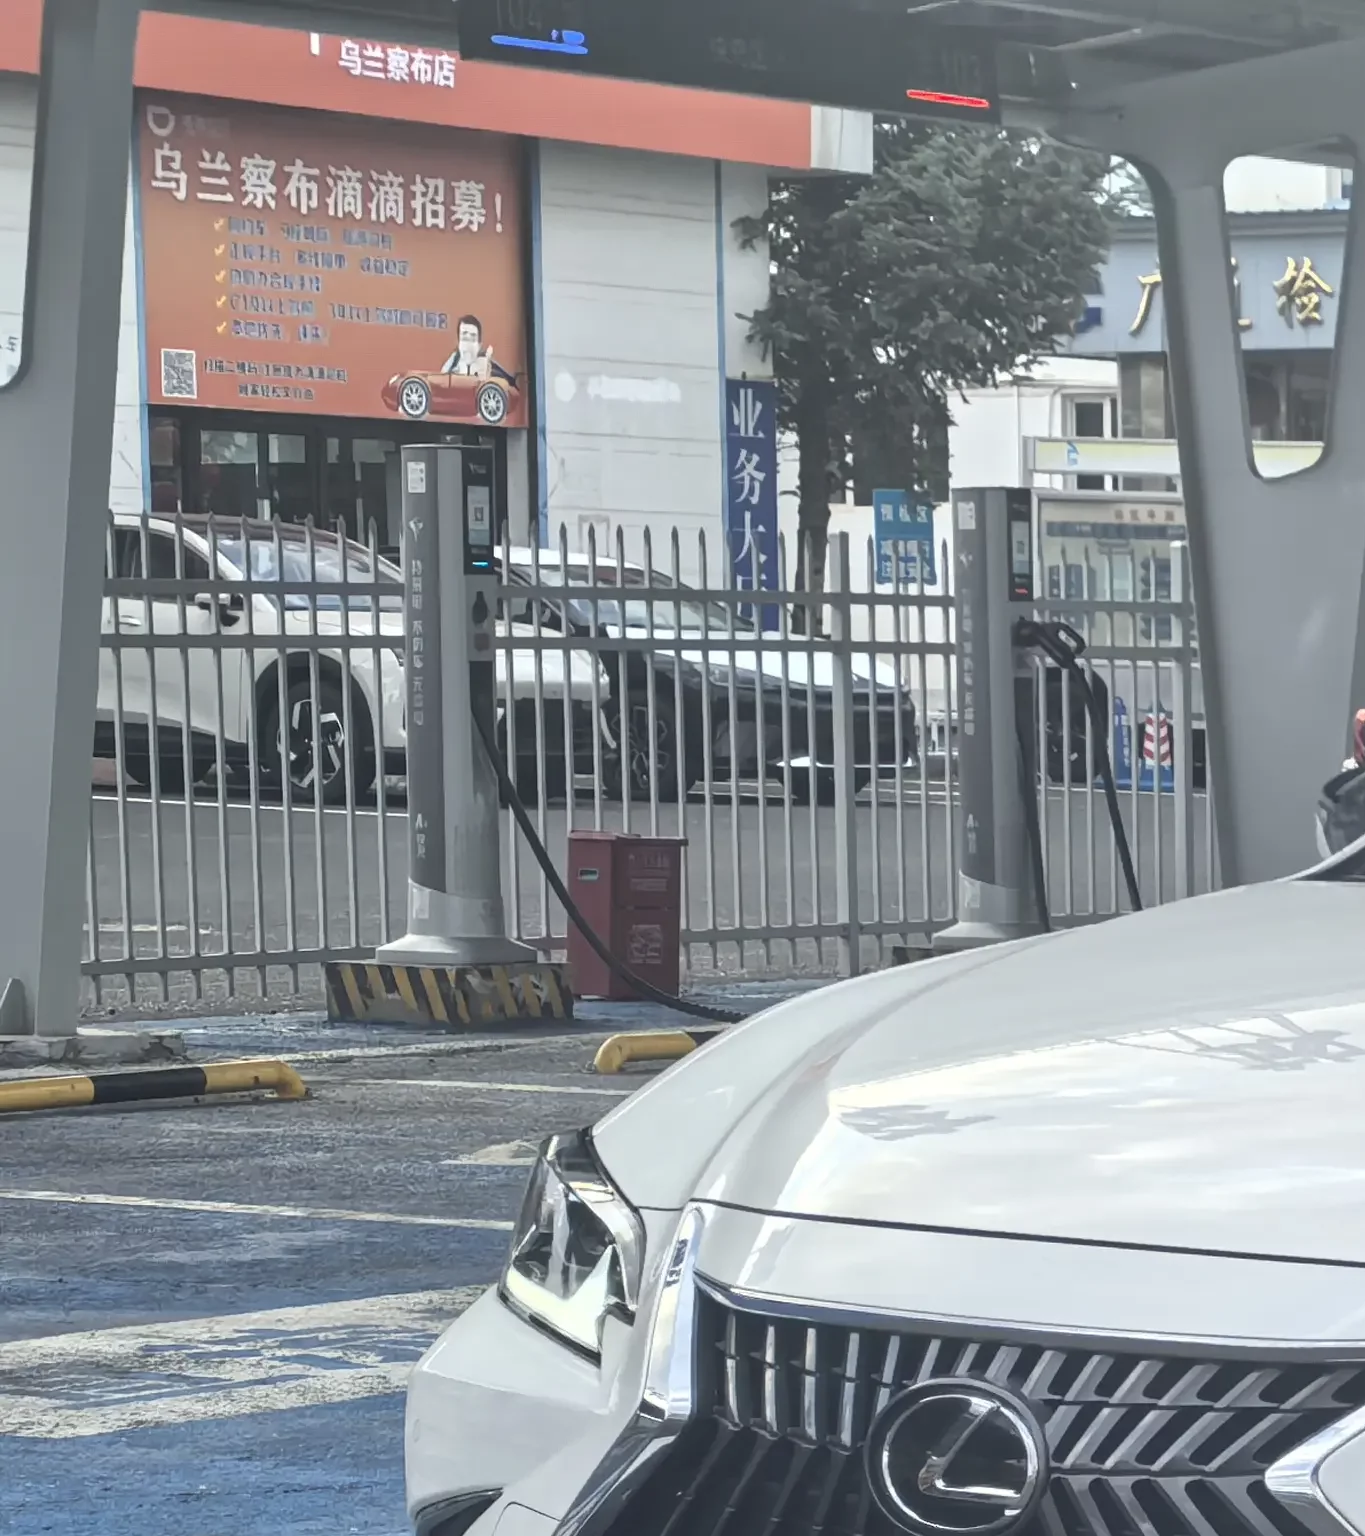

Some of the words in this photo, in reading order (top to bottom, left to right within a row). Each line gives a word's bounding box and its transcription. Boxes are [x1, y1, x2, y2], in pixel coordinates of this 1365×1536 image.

[338, 39, 457, 89] 乌兰察布店
[150, 140, 504, 234] 乌兰察布滴滴招募！
